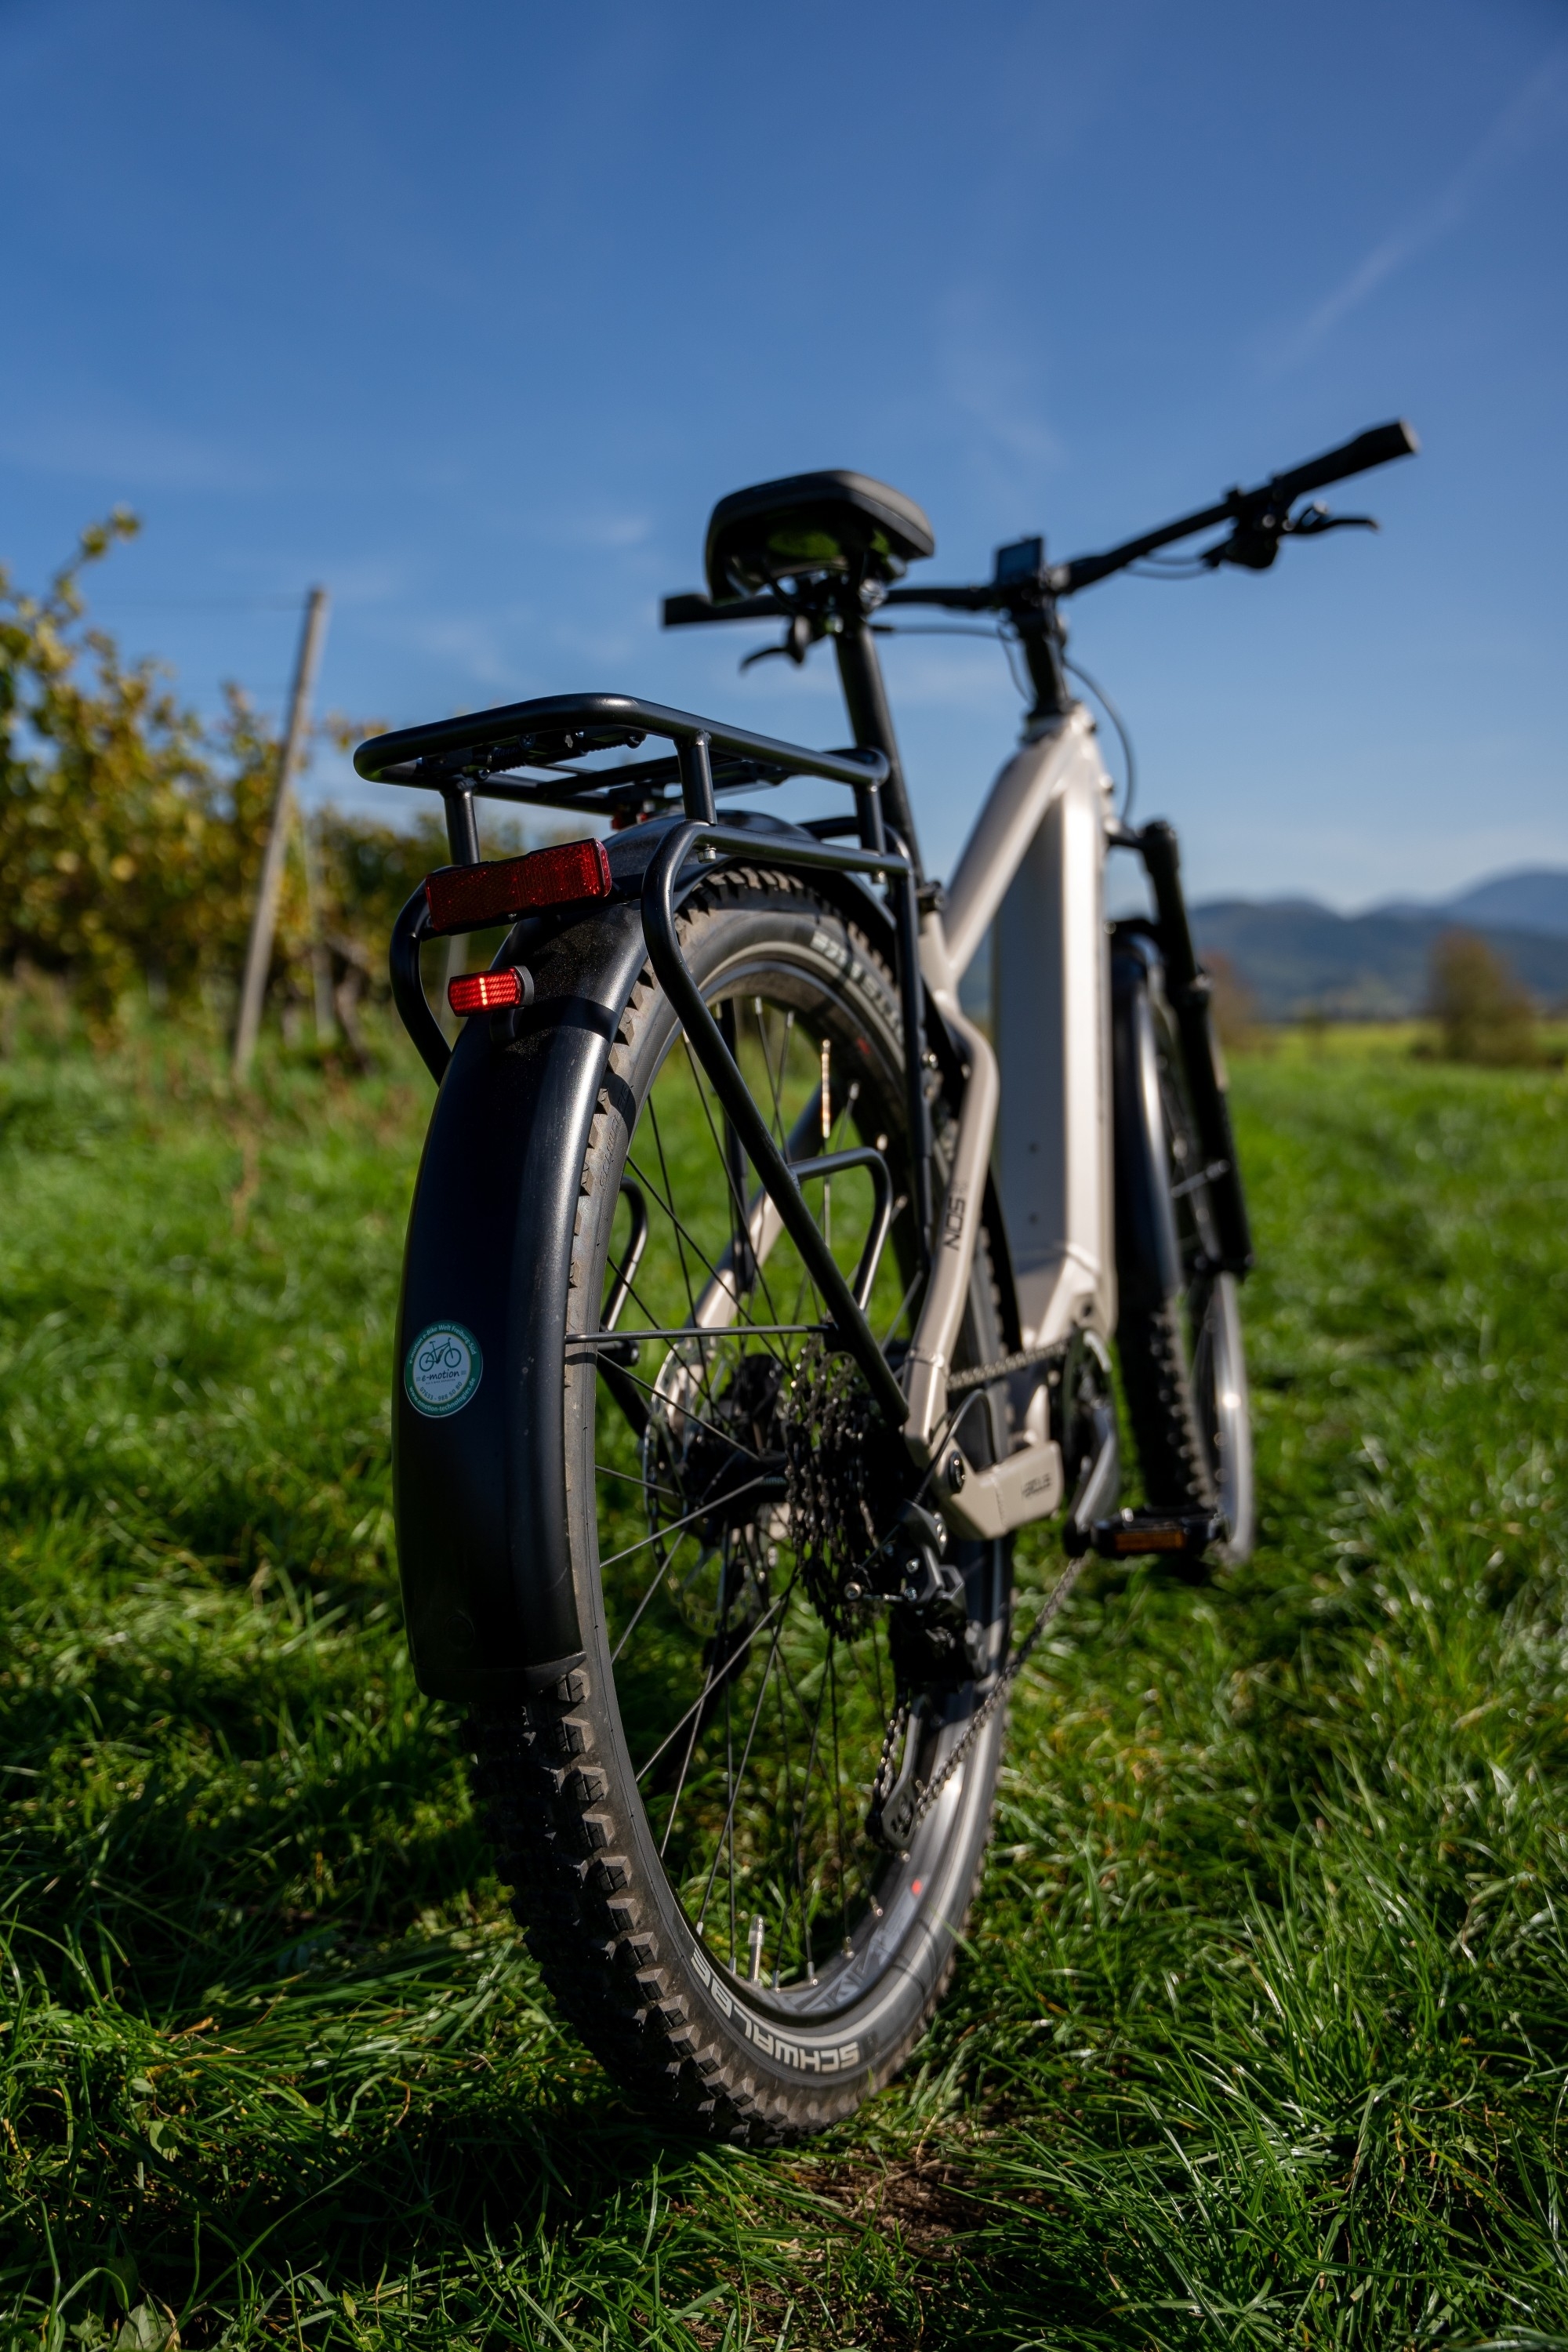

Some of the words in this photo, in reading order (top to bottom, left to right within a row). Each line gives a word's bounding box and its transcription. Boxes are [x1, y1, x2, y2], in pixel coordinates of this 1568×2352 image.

[409, 1336, 423, 1364] e-motion
[423, 1327, 437, 1339] e-Bike
[452, 1325, 477, 1356] Freiburg-Süd
[422, 1369, 460, 1382] e-motion
[408, 1377, 476, 1412] www.emotion-technologies.de
[691, 1947, 861, 2074] SCHWALBE
